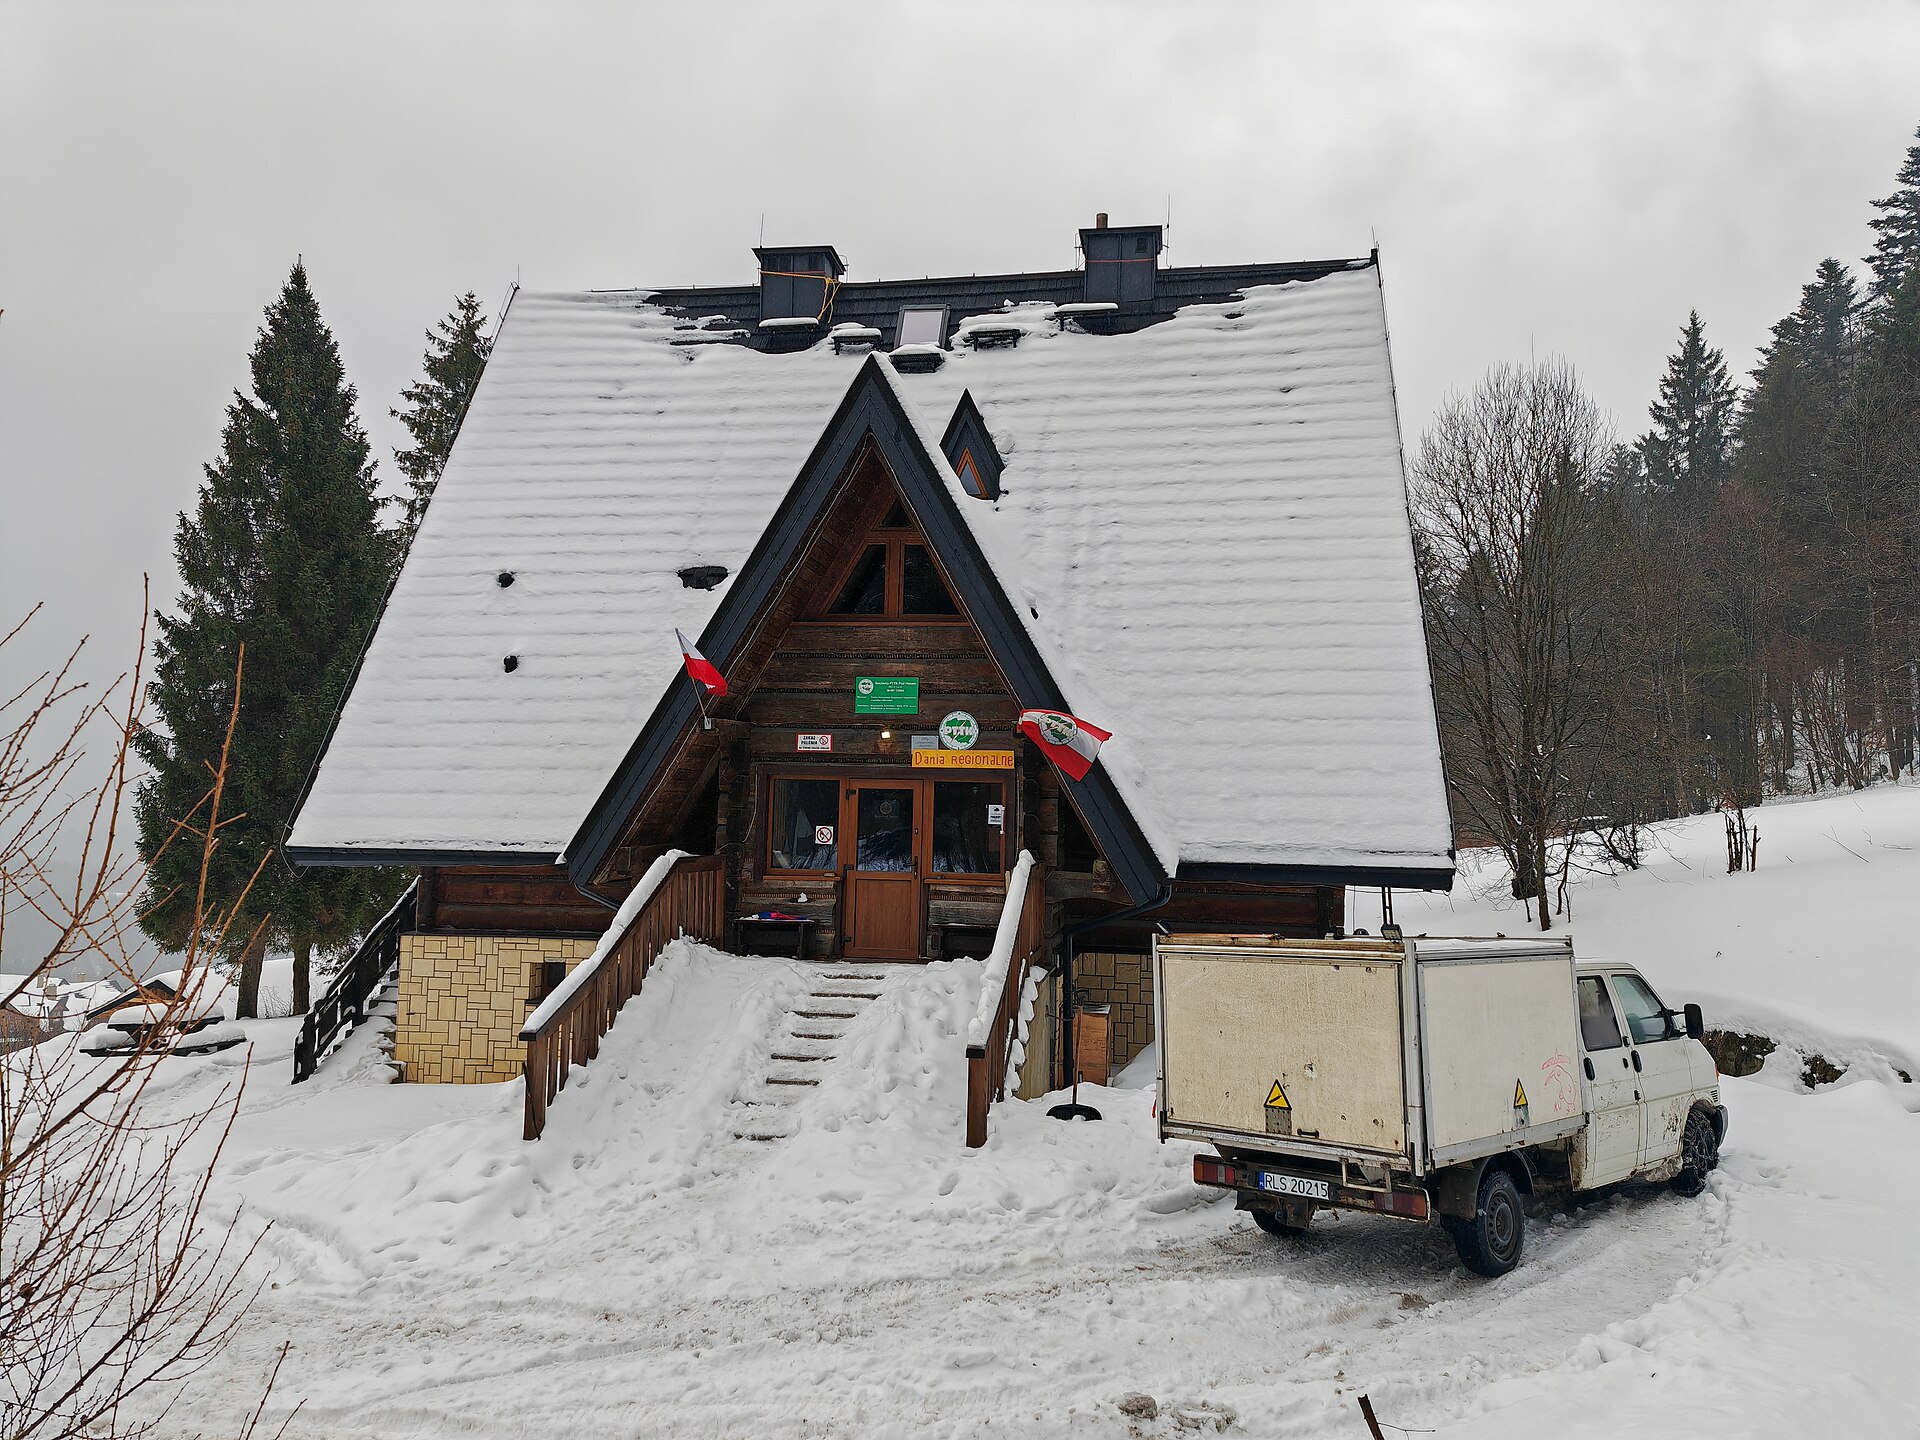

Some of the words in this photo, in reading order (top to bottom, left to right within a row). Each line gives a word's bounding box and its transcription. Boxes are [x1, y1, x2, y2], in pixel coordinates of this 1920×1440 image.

[944, 726, 974, 736] PTTK
[915, 751, 945, 765] Dania
[1265, 1174, 1288, 1191] RLS
[1290, 1178, 1328, 1198] 20215
